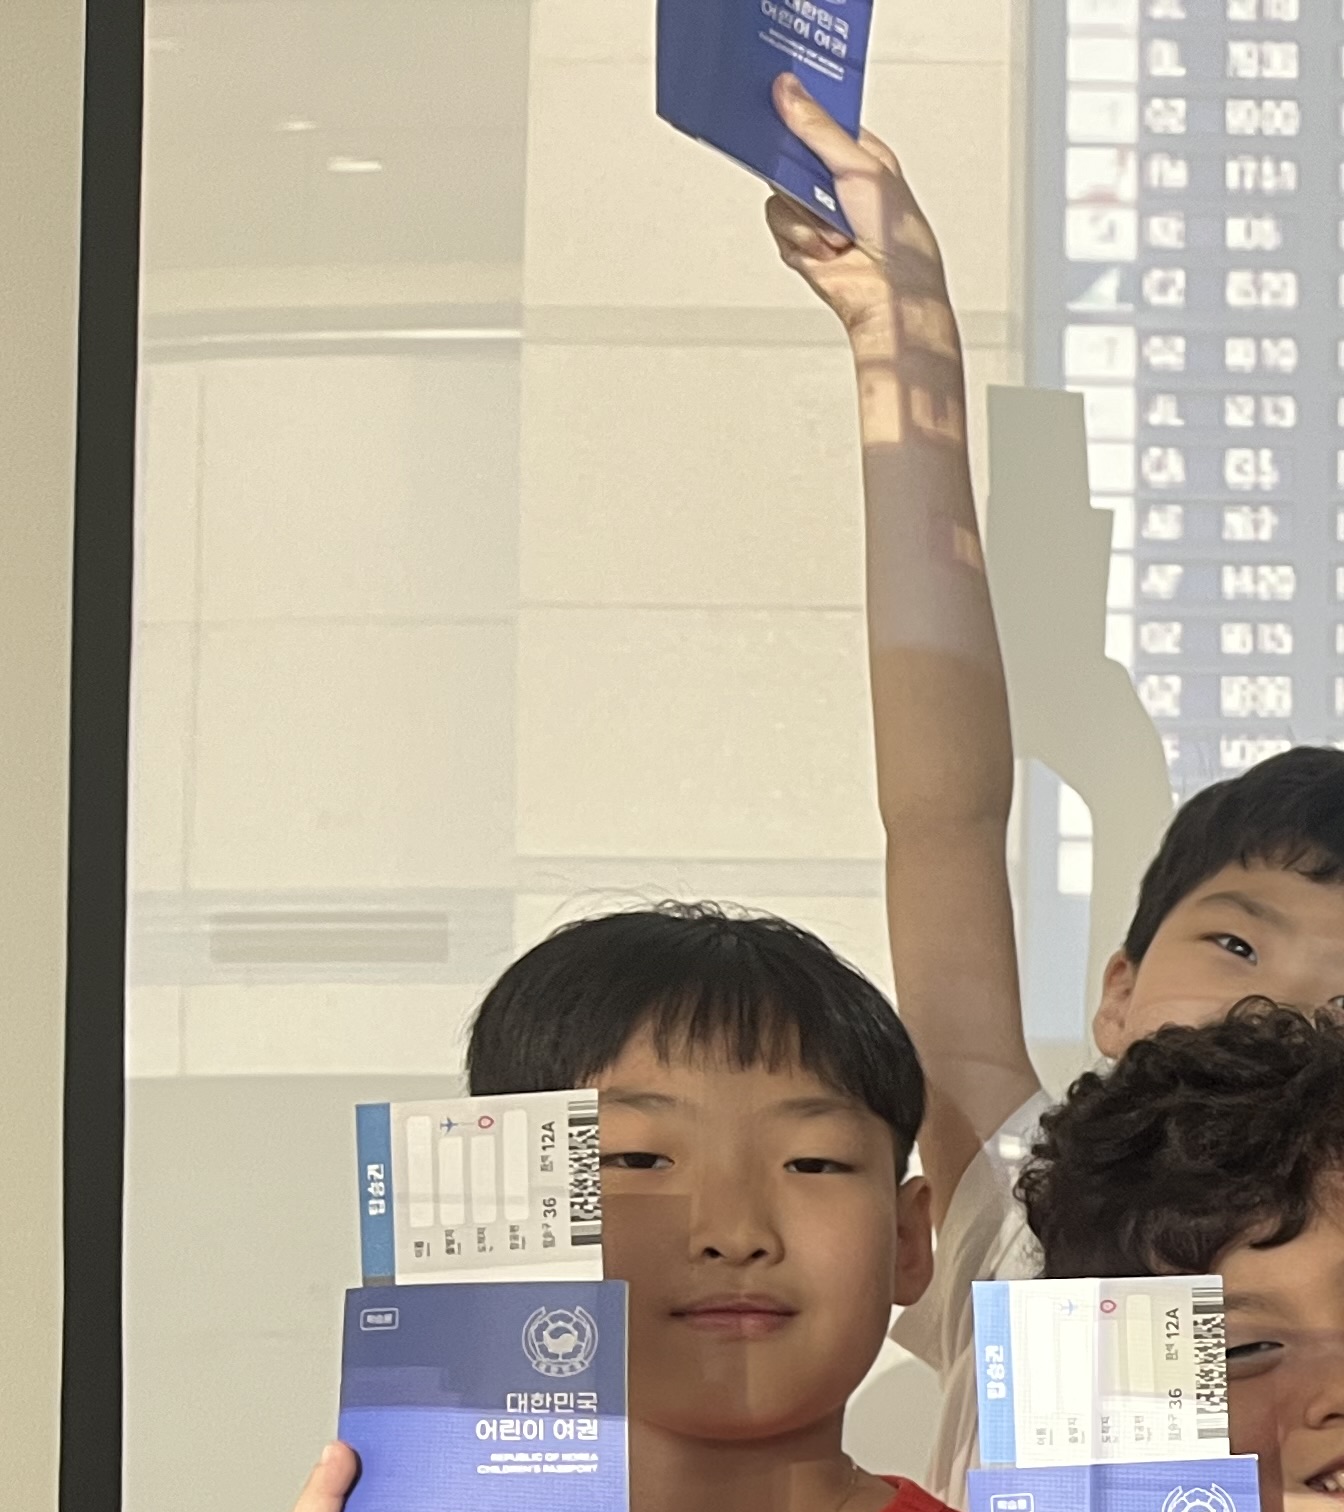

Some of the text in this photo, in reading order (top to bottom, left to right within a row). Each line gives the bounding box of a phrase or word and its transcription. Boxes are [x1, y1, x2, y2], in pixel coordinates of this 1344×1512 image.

[541, 1121, 555, 1151] 12A
[543, 1197, 557, 1218] 36
[1166, 1308, 1180, 1339] 12A
[506, 1392, 598, 1414] 대한민국
[1168, 1388, 1182, 1410] 36
[475, 1419, 598, 1441] 어린이 여권
